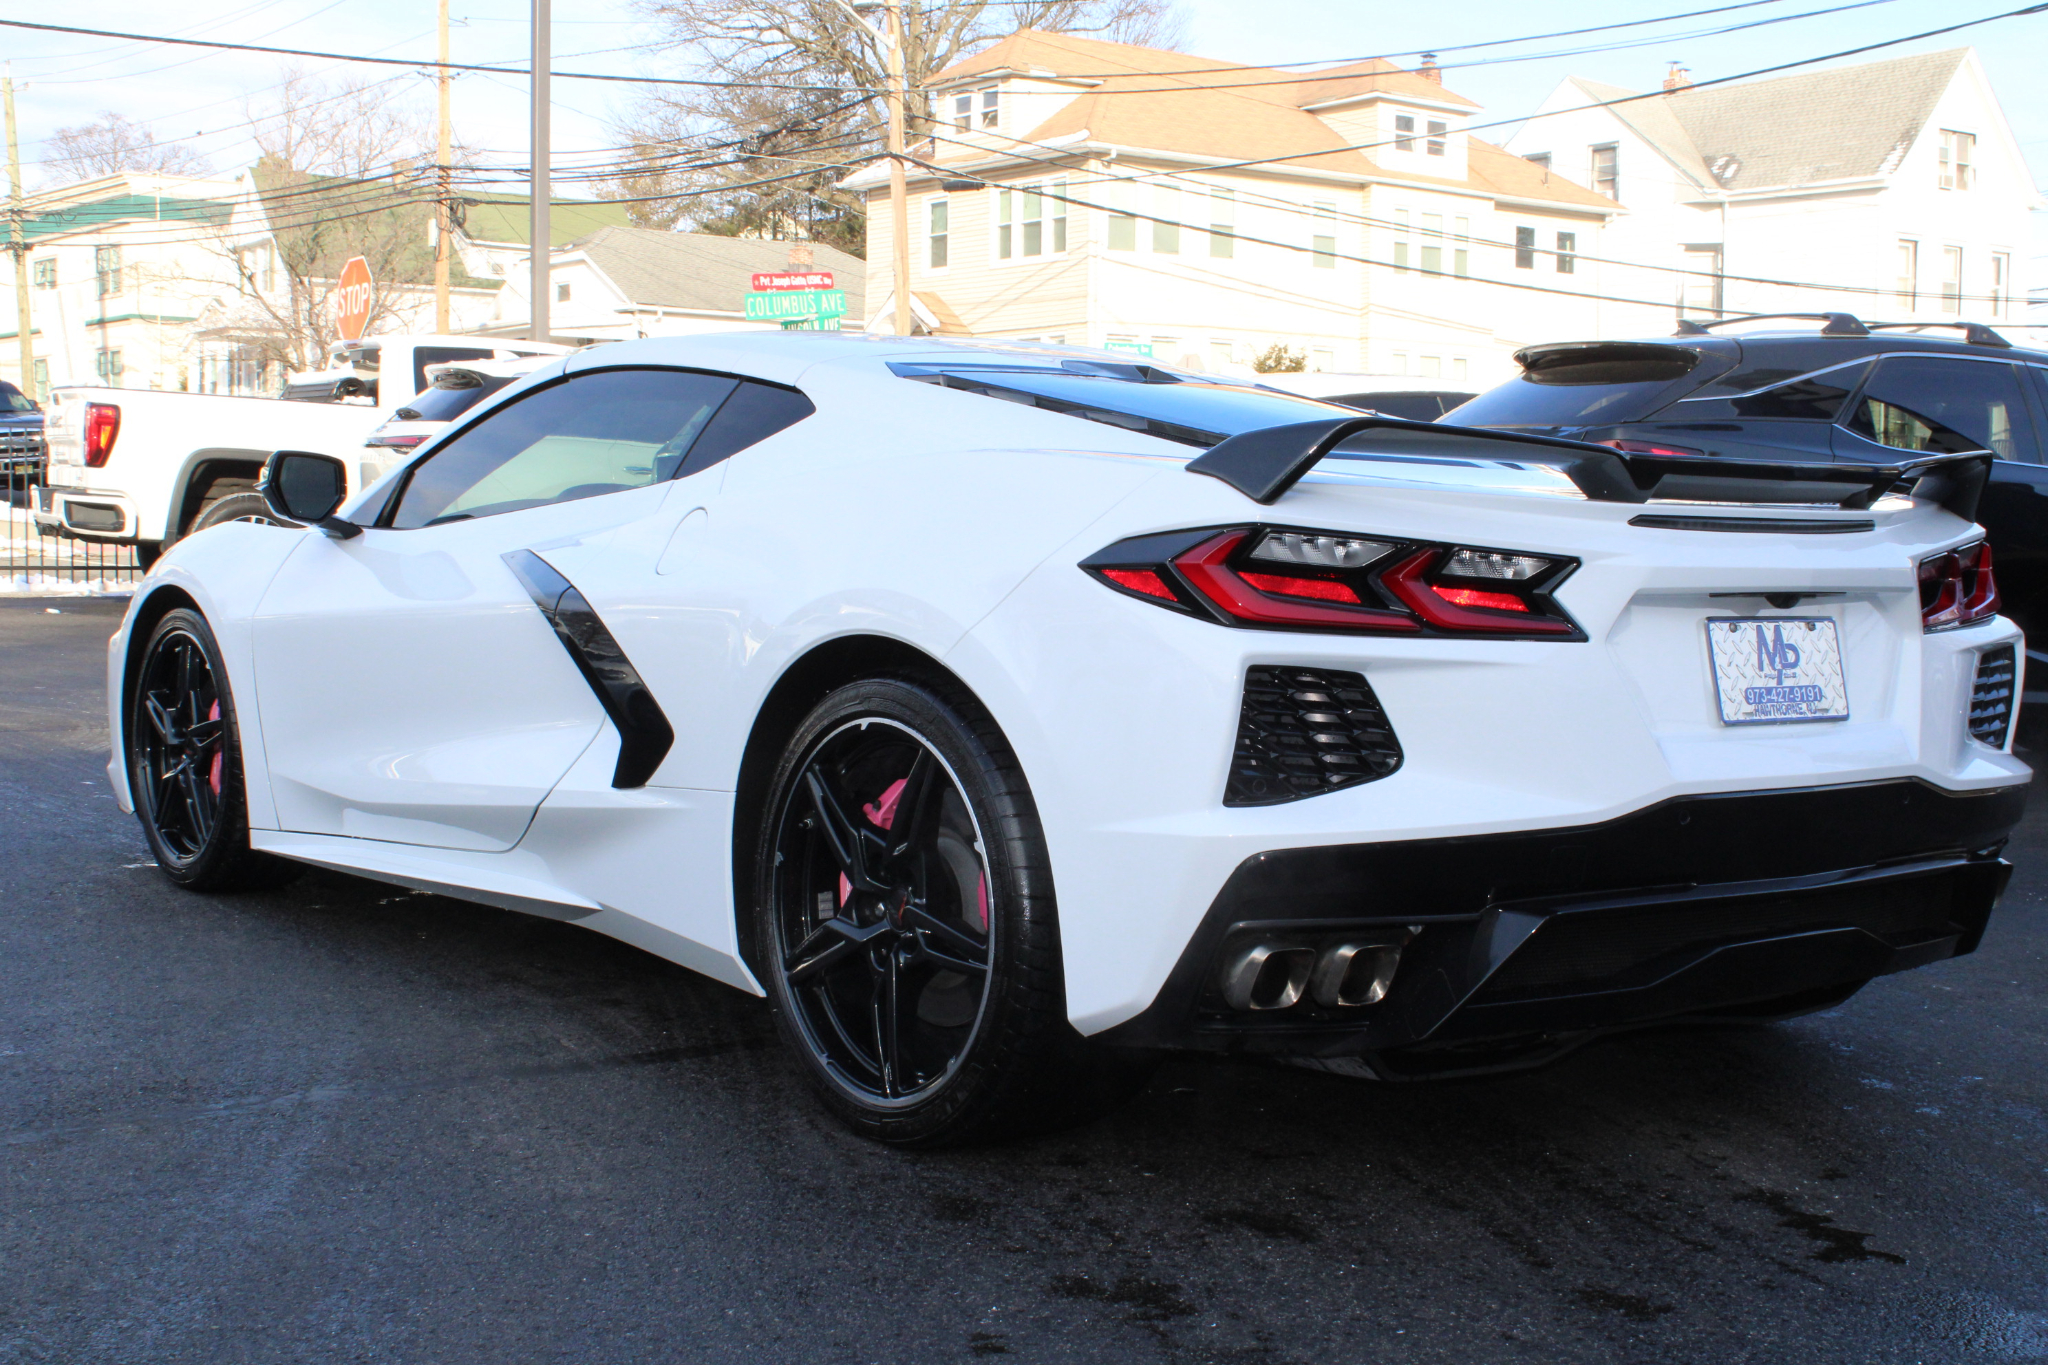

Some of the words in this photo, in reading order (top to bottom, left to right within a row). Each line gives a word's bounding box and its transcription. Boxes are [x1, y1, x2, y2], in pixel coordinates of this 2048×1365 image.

[338, 282, 369, 318] STOP
[747, 294, 817, 317] COLUMBUS
[821, 293, 845, 312] AVE
[824, 317, 840, 331] AVE
[1747, 686, 1821, 704] 973-427-9191
